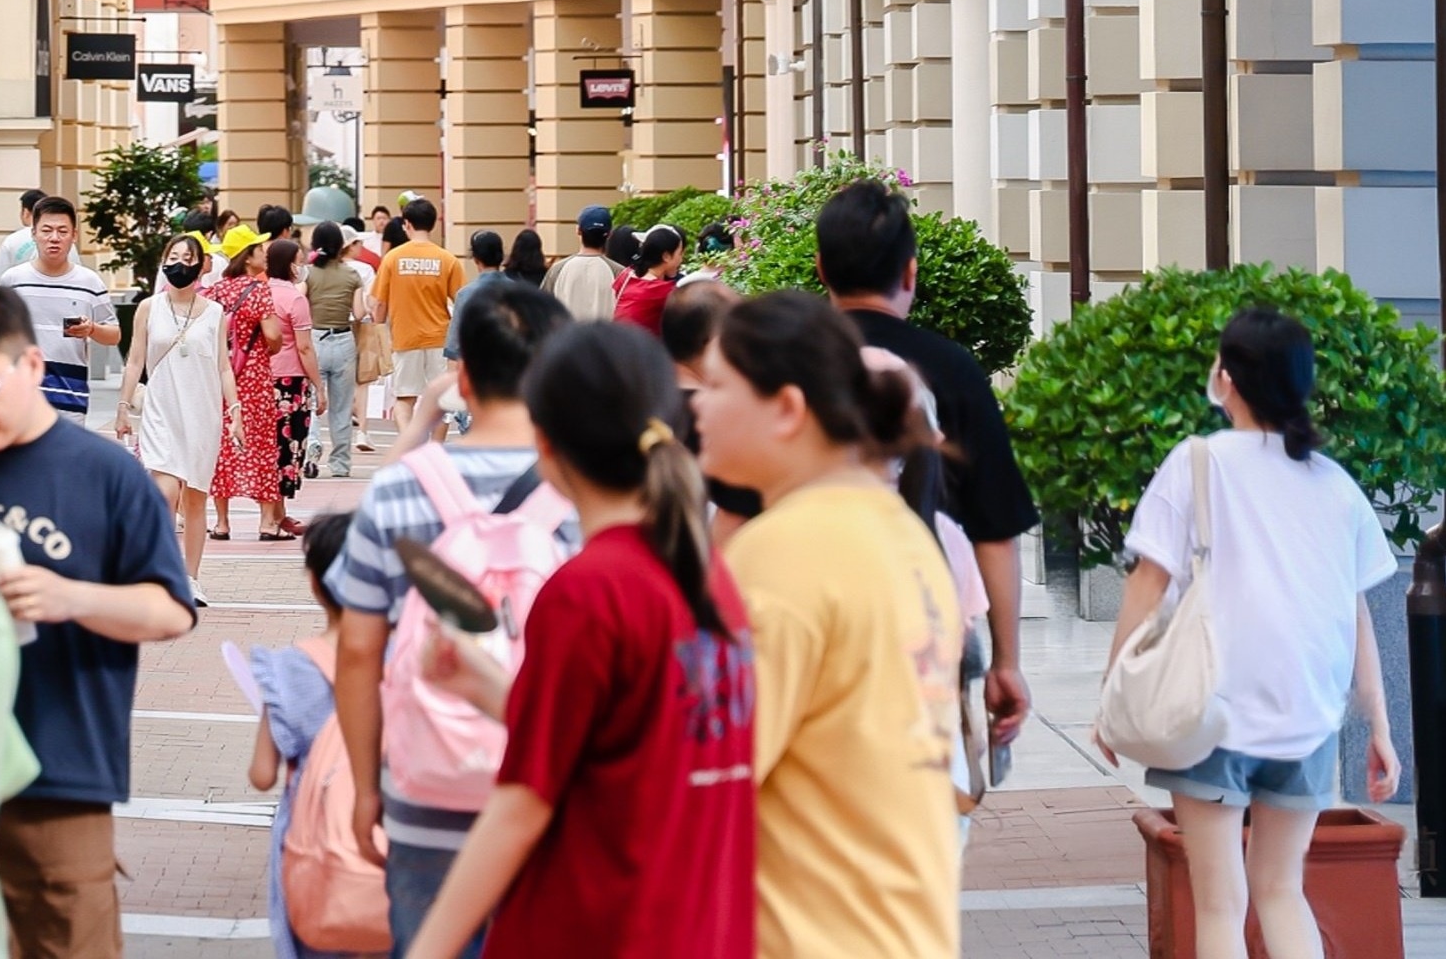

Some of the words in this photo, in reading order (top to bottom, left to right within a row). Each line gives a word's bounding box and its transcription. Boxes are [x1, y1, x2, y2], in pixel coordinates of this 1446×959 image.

[71, 50, 105, 62] Calvin
[105, 51, 131, 63] Klein
[140, 73, 192, 93] VANS
[398, 257, 442, 271] FUSION
